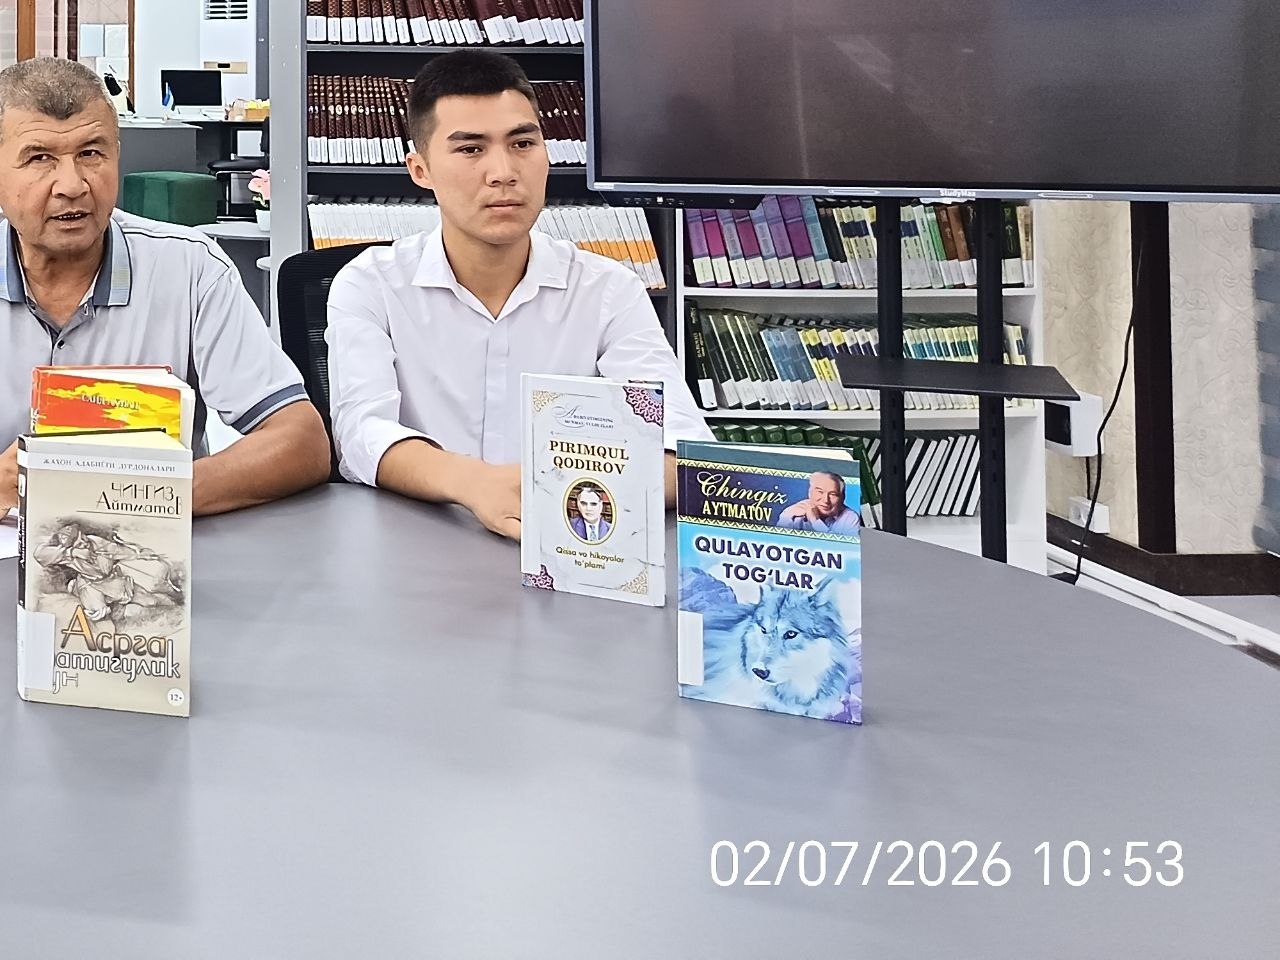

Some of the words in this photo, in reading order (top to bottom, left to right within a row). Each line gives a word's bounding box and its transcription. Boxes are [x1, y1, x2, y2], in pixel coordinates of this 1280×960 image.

[549, 440, 630, 461] PIRIMQUL
[553, 455, 626, 475] QODIROV
[111, 482, 175, 501] ЧИНГИЗ
[697, 471, 789, 507] Chingiz
[96, 491, 182, 515] Айтматов
[702, 500, 773, 523] AYTMATOV
[555, 546, 577, 556] Qissa
[694, 535, 843, 570] QULAYOTGAN
[722, 562, 814, 590] TOG'LAR
[55, 639, 181, 683] атигулик
